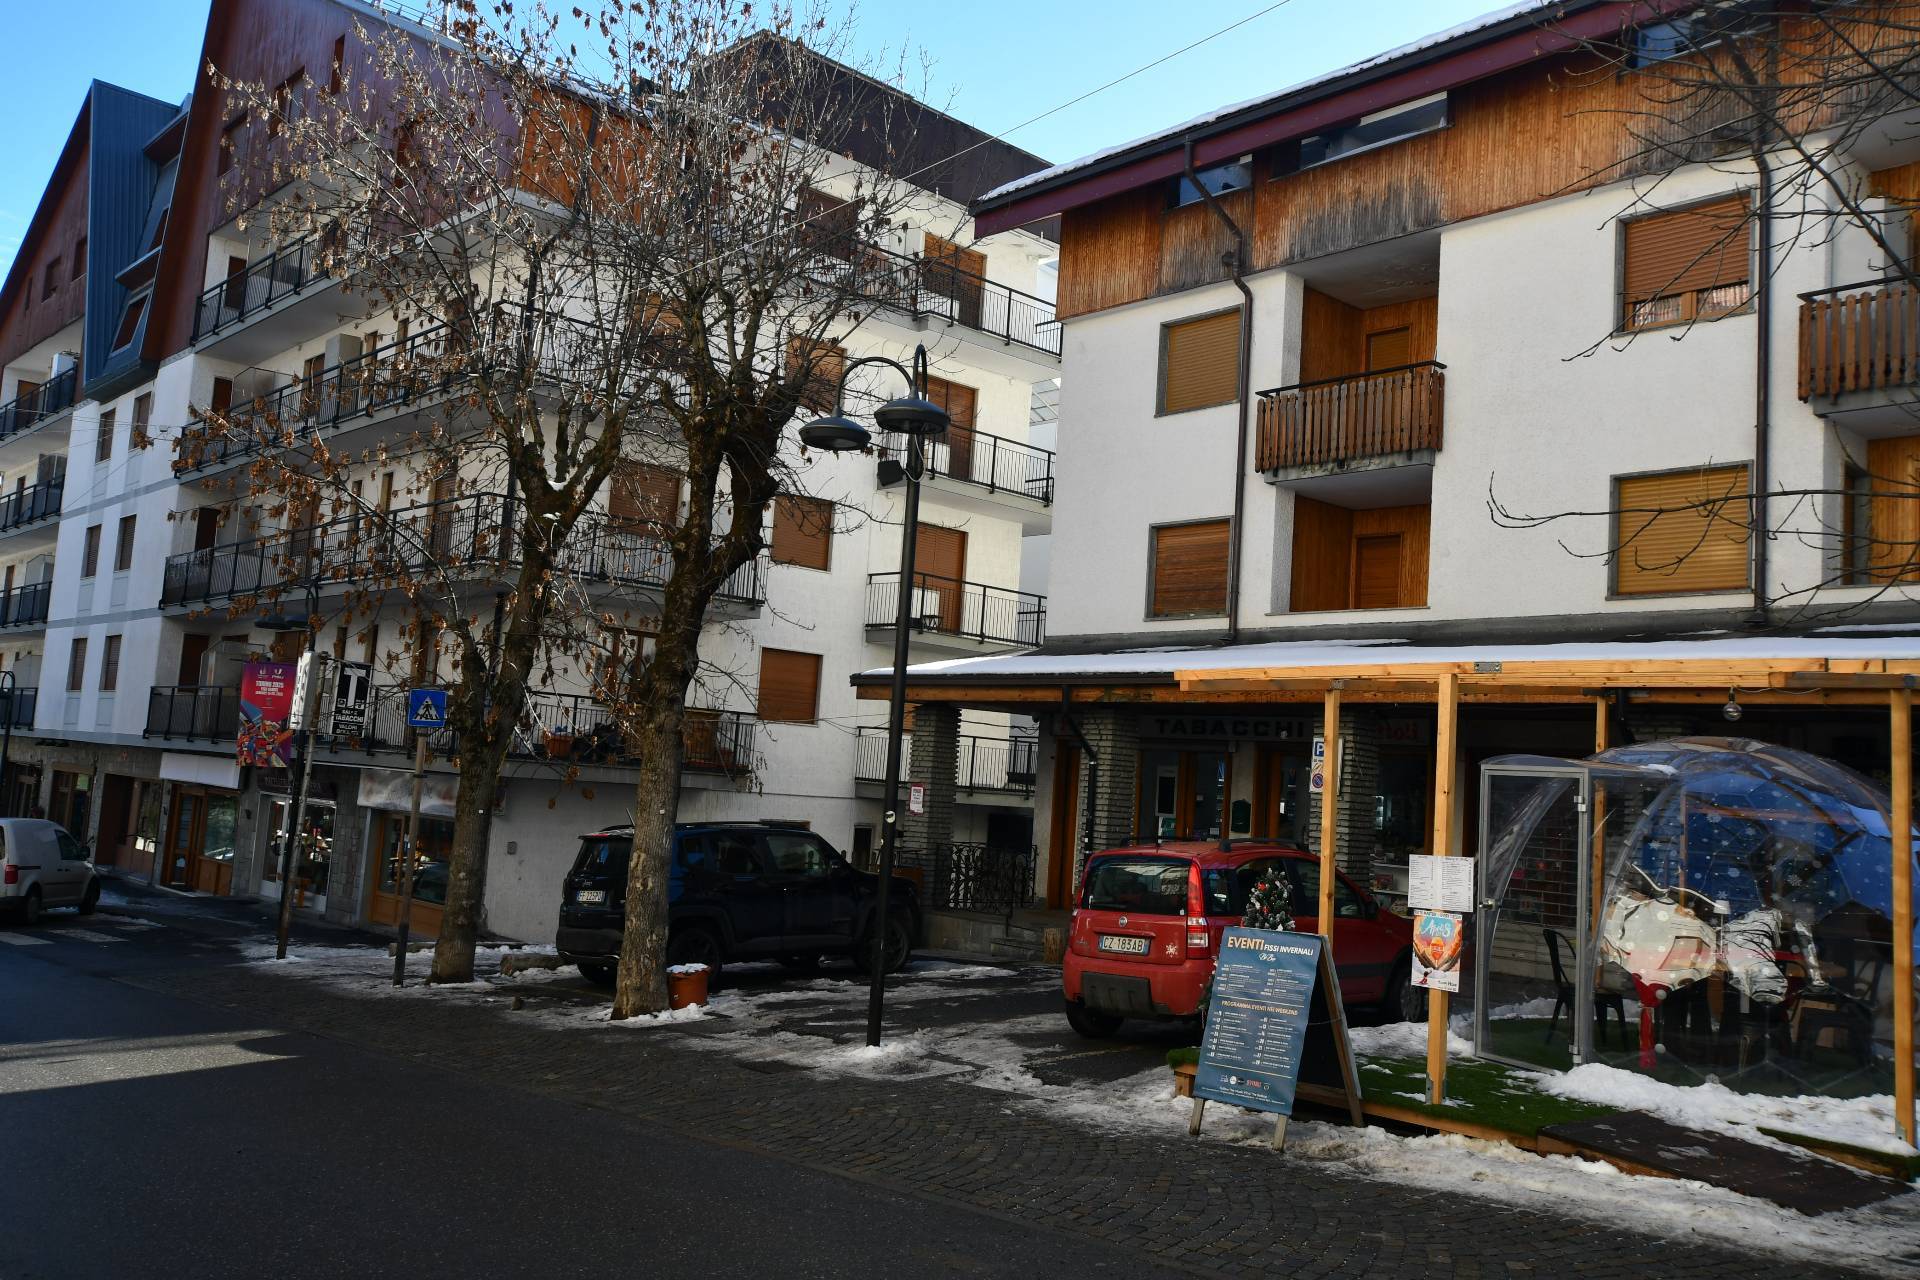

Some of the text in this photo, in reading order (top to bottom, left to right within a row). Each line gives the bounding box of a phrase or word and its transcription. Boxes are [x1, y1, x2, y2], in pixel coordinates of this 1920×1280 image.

[335, 714, 364, 723] TABACCHI
[1155, 718, 1304, 737] TABACCHI
[1103, 936, 1114, 949] CZ
[1117, 938, 1143, 952] 183AB
[1227, 936, 1314, 956] EVENTI FISSI INVERNALI
[1221, 1000, 1252, 1010] PROGRAMMA
